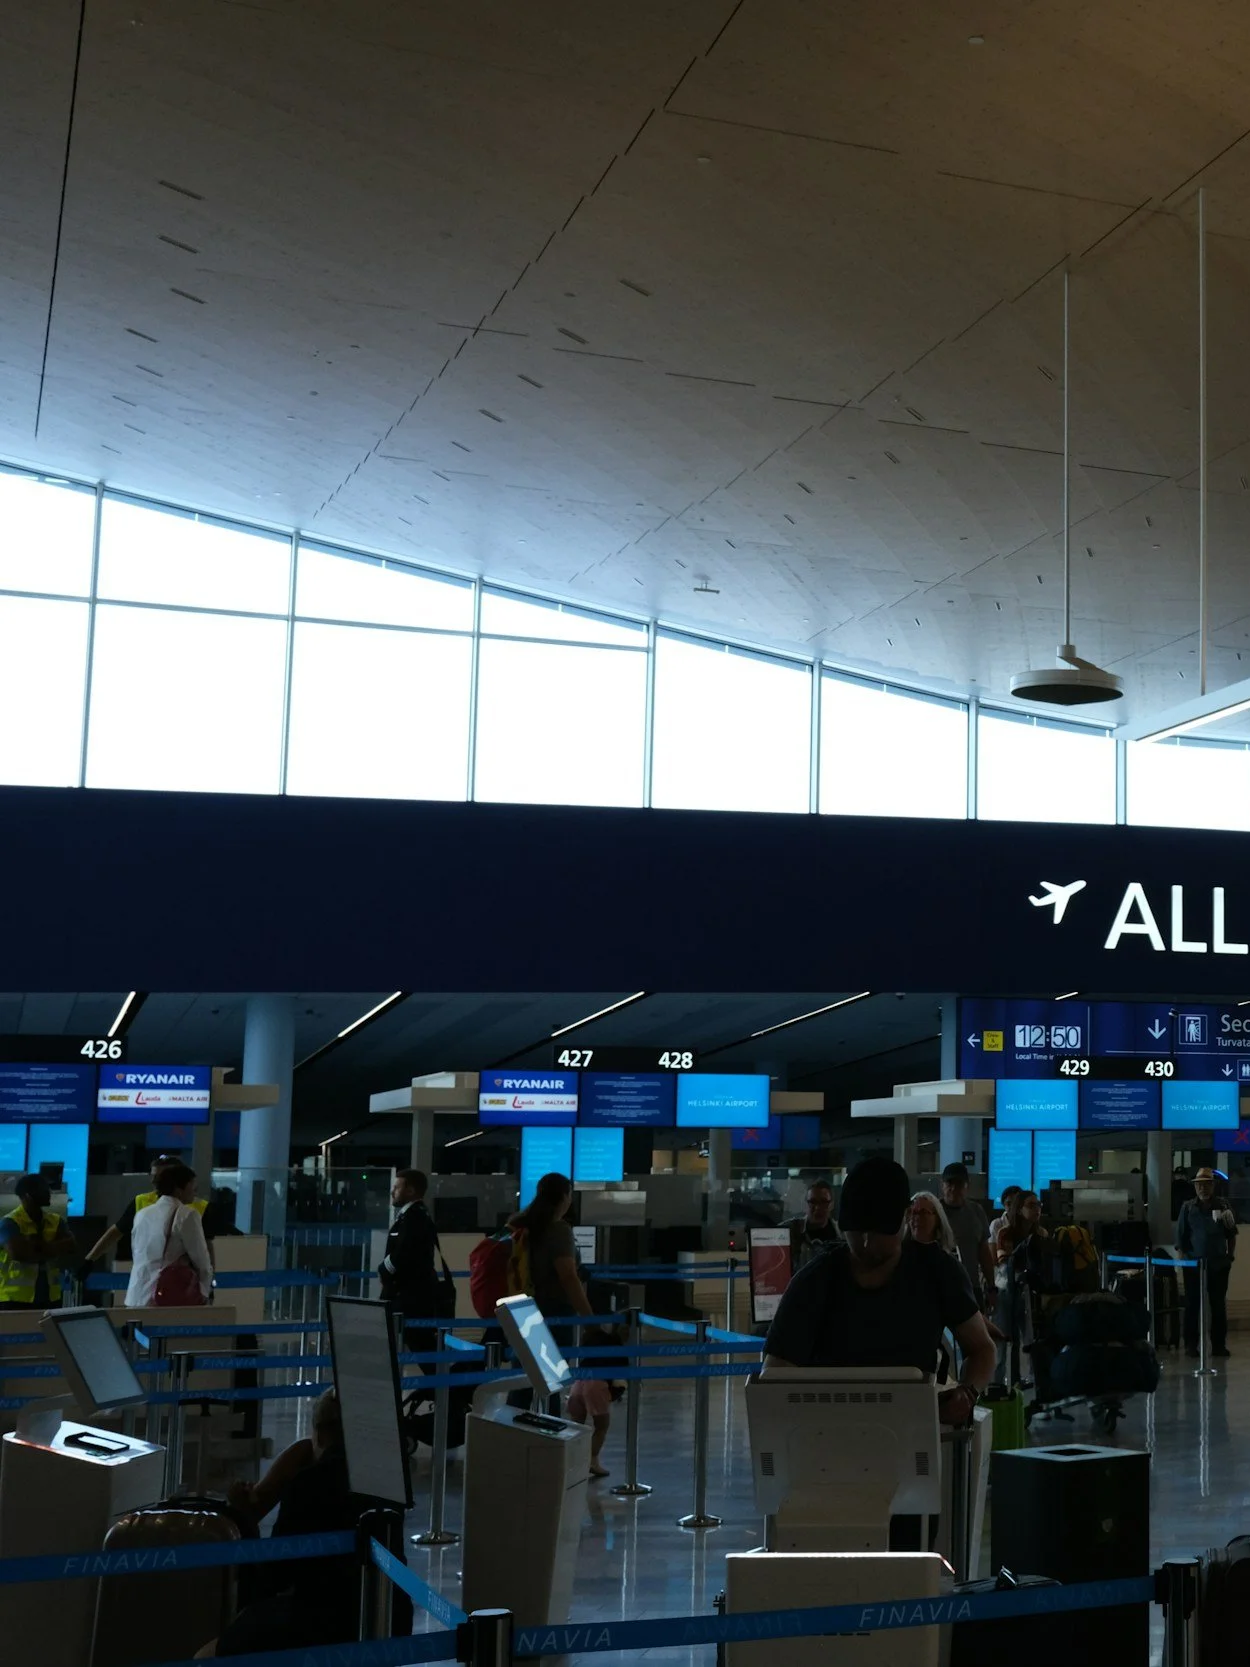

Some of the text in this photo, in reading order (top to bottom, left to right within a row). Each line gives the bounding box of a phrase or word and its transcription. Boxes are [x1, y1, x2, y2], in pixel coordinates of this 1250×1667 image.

[1103, 882, 1249, 955] ALL
[1015, 1025, 1081, 1048] 12:50
[80, 1040, 123, 1059] 426
[1015, 1053, 1032, 1061] Local
[1033, 1053, 1048, 1061] Time
[557, 1049, 594, 1067] 427
[658, 1052, 693, 1069] 428
[1059, 1059, 1091, 1076] 429
[1144, 1061, 1175, 1077] 430
[125, 1073, 196, 1085] RYANAIR
[503, 1078, 565, 1090] RYANAIR
[724, 1100, 758, 1108] AIRPORT
[1005, 1103, 1069, 1111] HELSINKI AIRPORT
[1202, 1104, 1231, 1112] AIRPORT
[202, 1358, 257, 1368] FINAVIA
[63, 1549, 178, 1575] FINAVIA
[858, 1599, 972, 1628] FINAVIA
